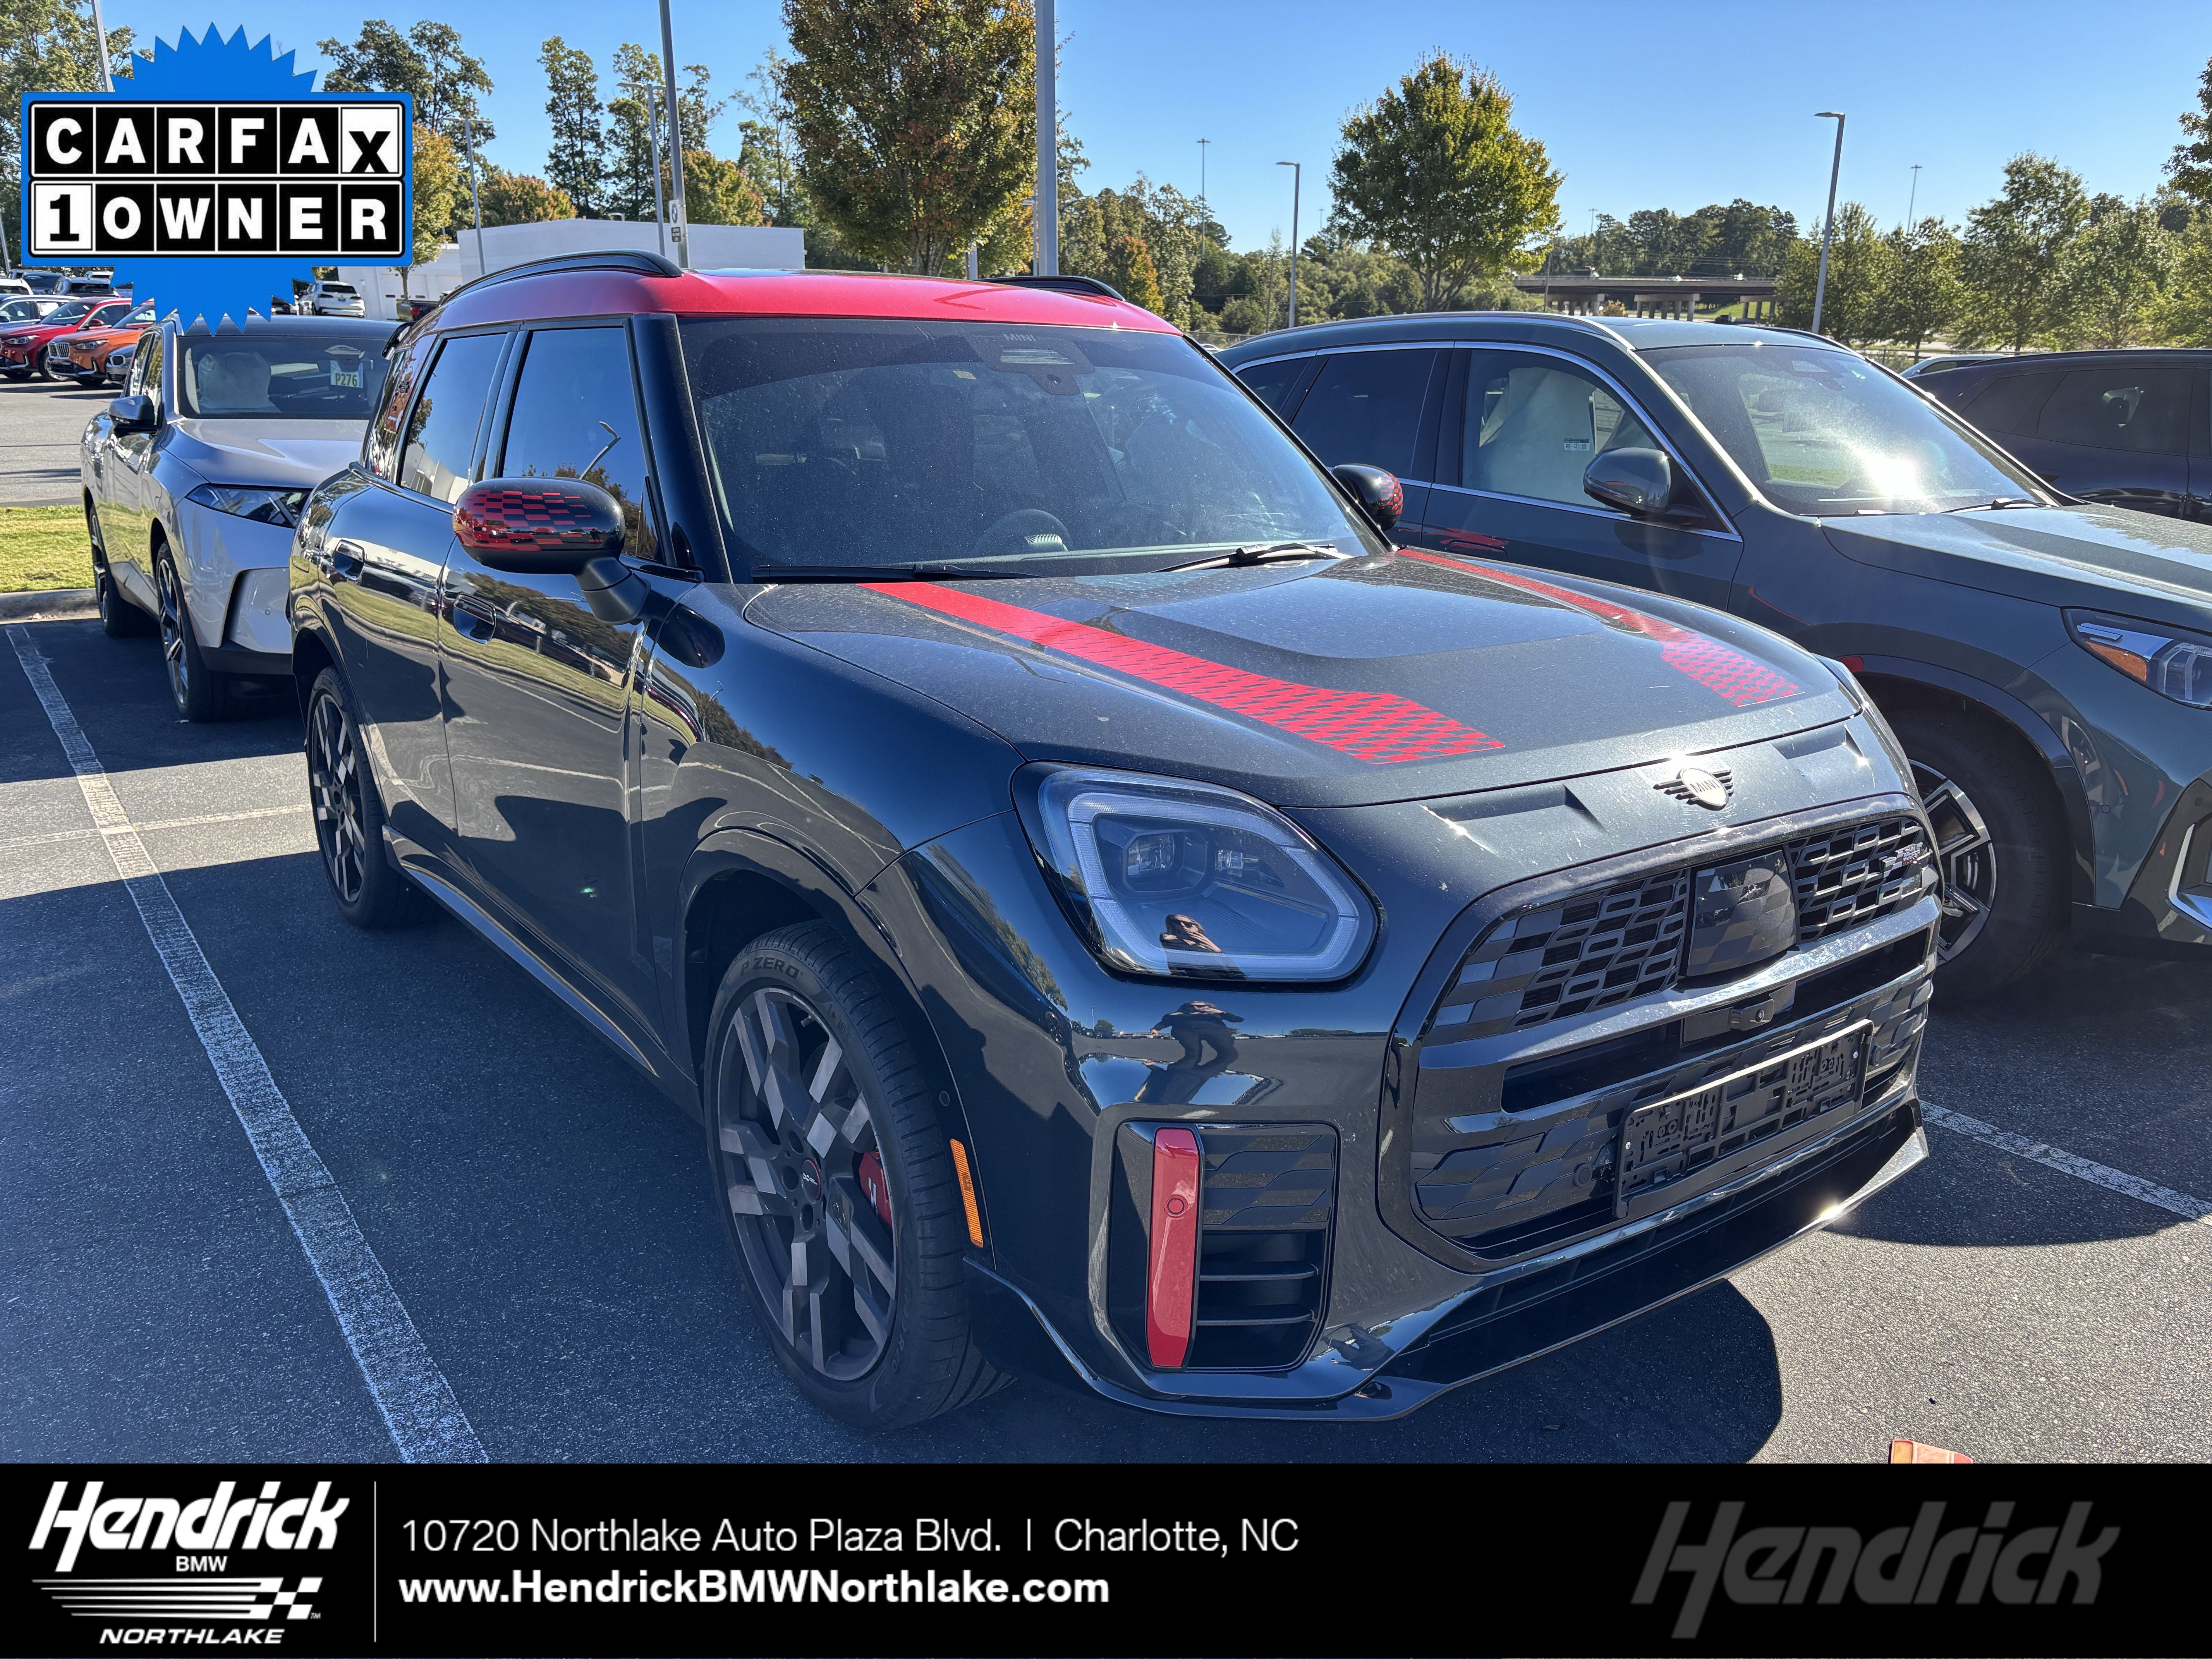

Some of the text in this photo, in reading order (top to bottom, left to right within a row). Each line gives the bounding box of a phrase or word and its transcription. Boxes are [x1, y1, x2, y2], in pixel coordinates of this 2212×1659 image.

[1002, 333, 1037, 342] MINI
[335, 373, 357, 386] P276
[1689, 779, 1720, 793] MINI
[740, 957, 800, 979] P ZERO
